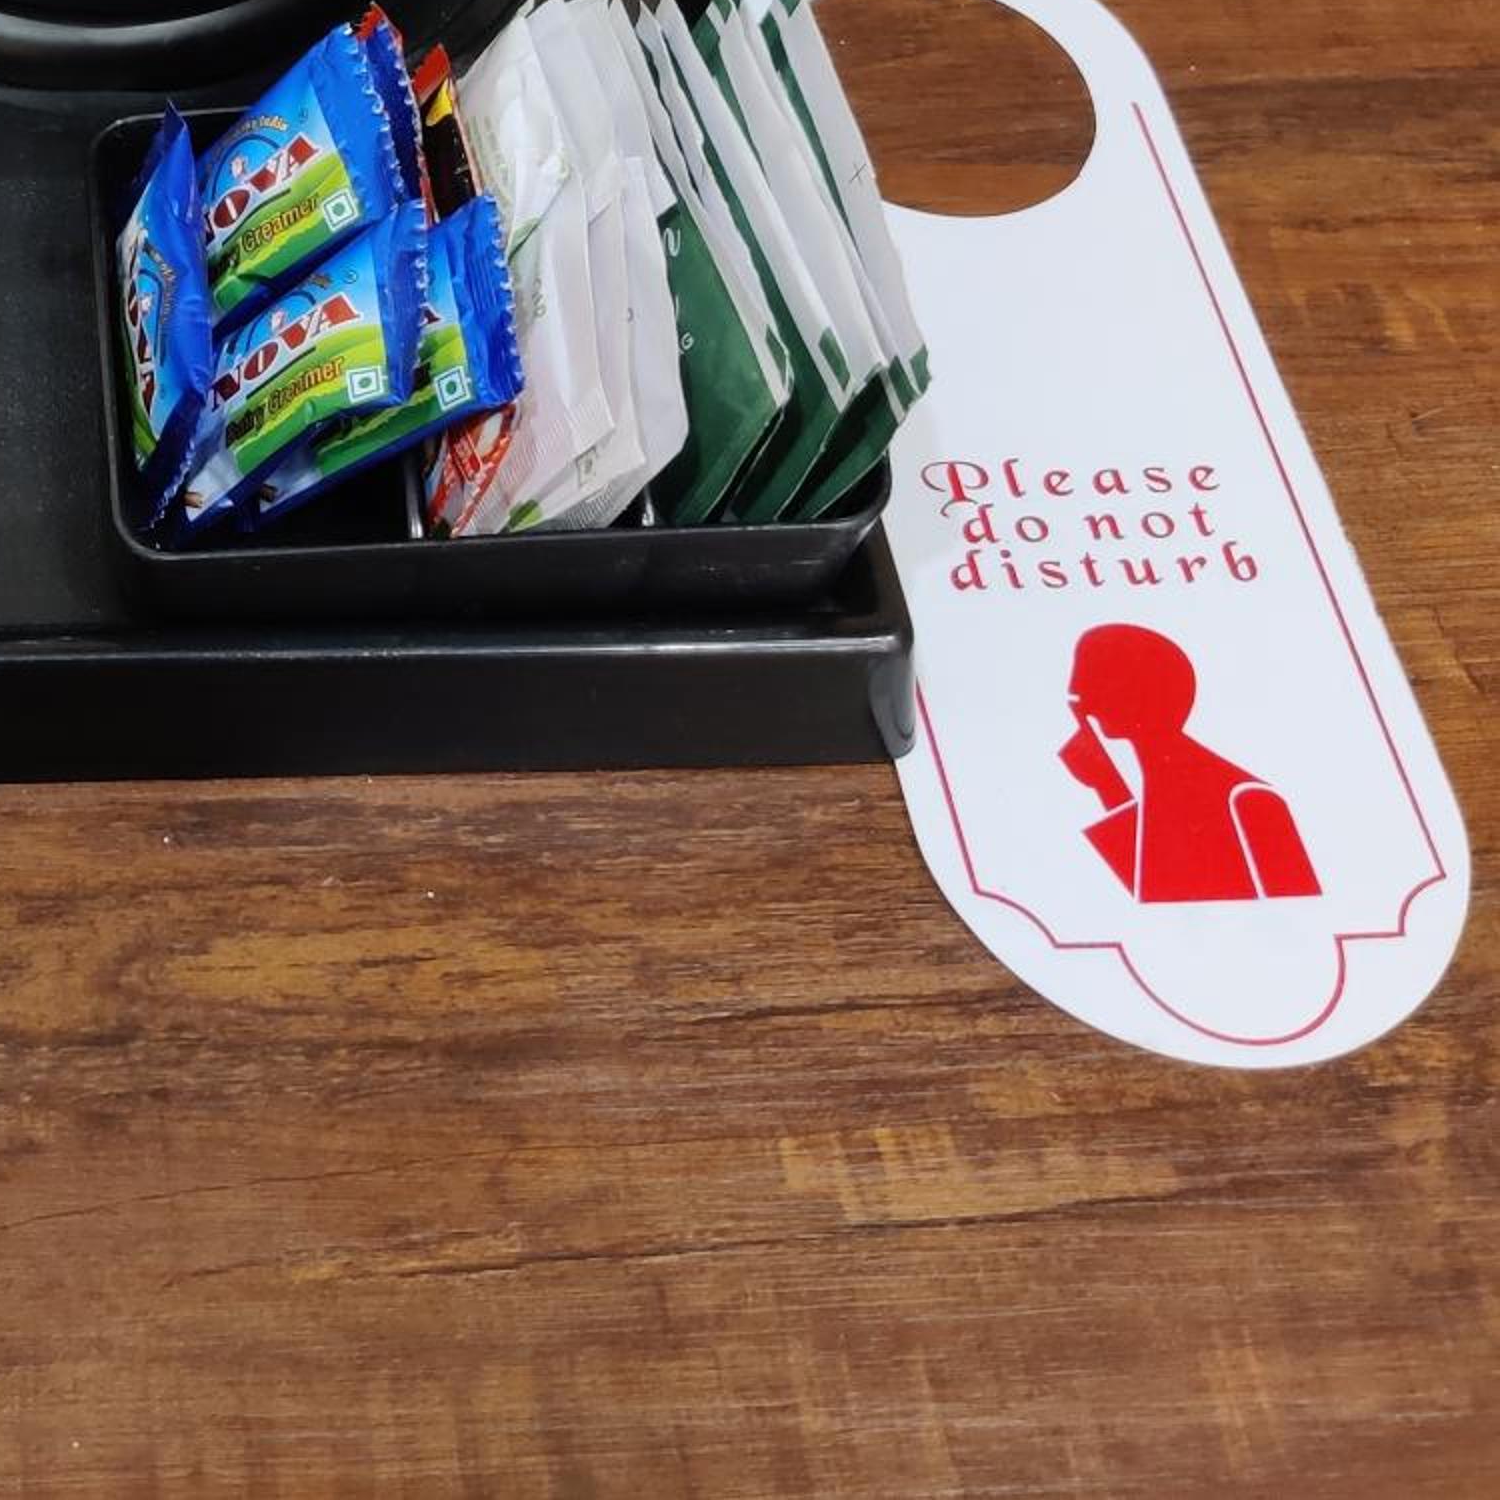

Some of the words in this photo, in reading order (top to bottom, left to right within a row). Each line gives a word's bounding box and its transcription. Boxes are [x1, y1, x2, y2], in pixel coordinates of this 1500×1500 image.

[242, 191, 320, 252] Creamer
[210, 290, 363, 412] NOVA
[267, 355, 344, 416] Creamer
[920, 457, 1221, 515] Please
[962, 503, 1050, 544] do
[1083, 501, 1216, 541] not
[949, 539, 1259, 591] disturb
